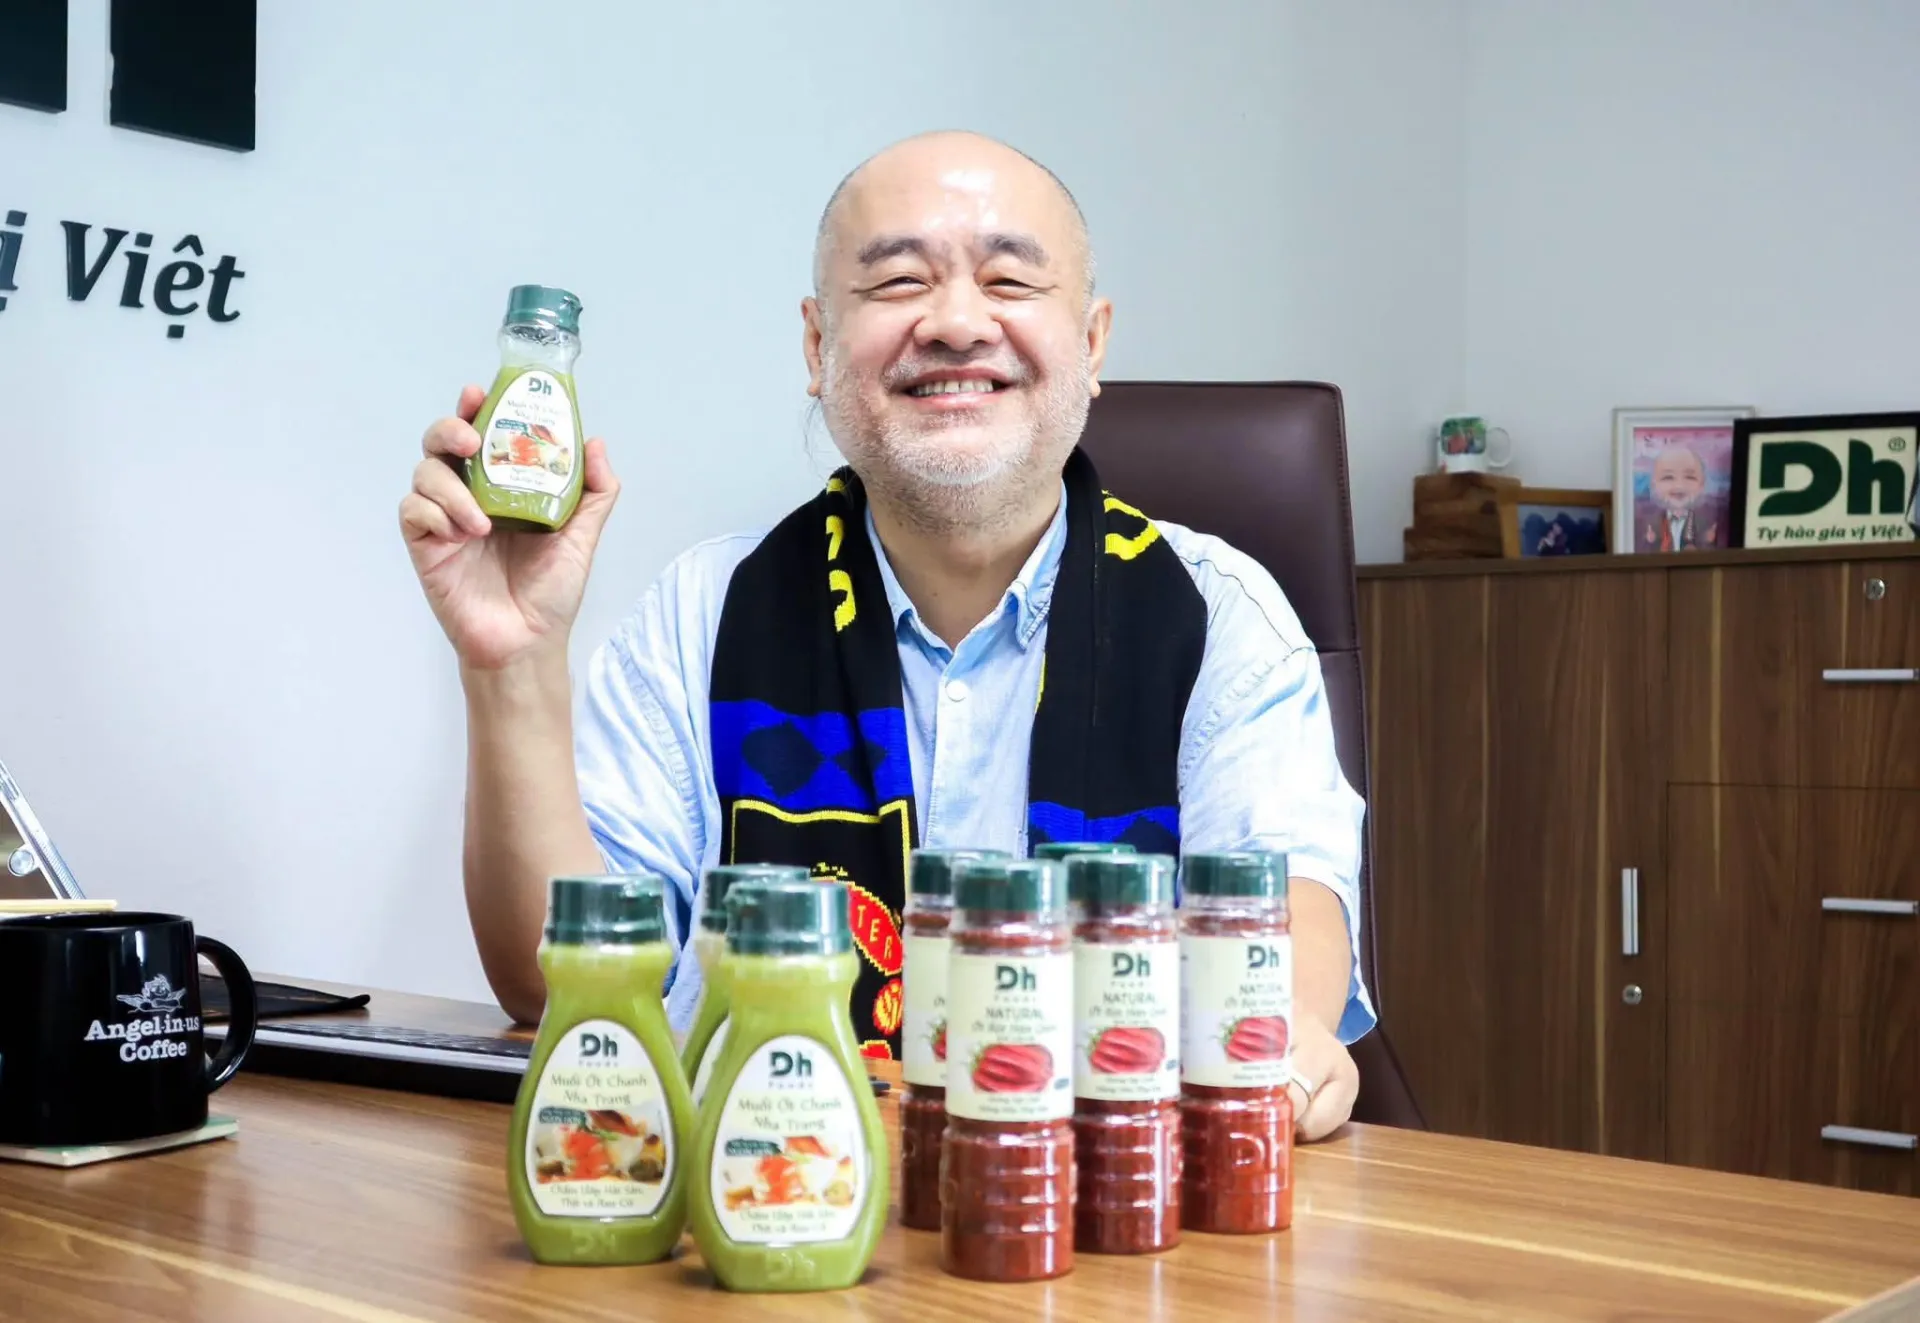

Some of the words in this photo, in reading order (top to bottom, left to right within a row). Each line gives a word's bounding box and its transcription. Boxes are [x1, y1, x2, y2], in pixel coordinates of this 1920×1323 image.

[59, 219, 246, 339] Việt
[528, 376, 553, 396] Dh
[1758, 438, 1906, 517] Dh
[1757, 526, 1780, 543] Tự
[1784, 525, 1816, 539] hào
[1818, 525, 1846, 541] gia
[1871, 524, 1904, 539] Việt
[1112, 952, 1151, 977] Dh
[1248, 944, 1280, 969] Dh
[996, 964, 1037, 991] Dh
[119, 1038, 188, 1062] Coffee
[579, 1032, 619, 1058] Dh
[770, 1050, 813, 1078] Dh
[606, 1072, 648, 1088] Chanh
[595, 1092, 632, 1107] Trang
